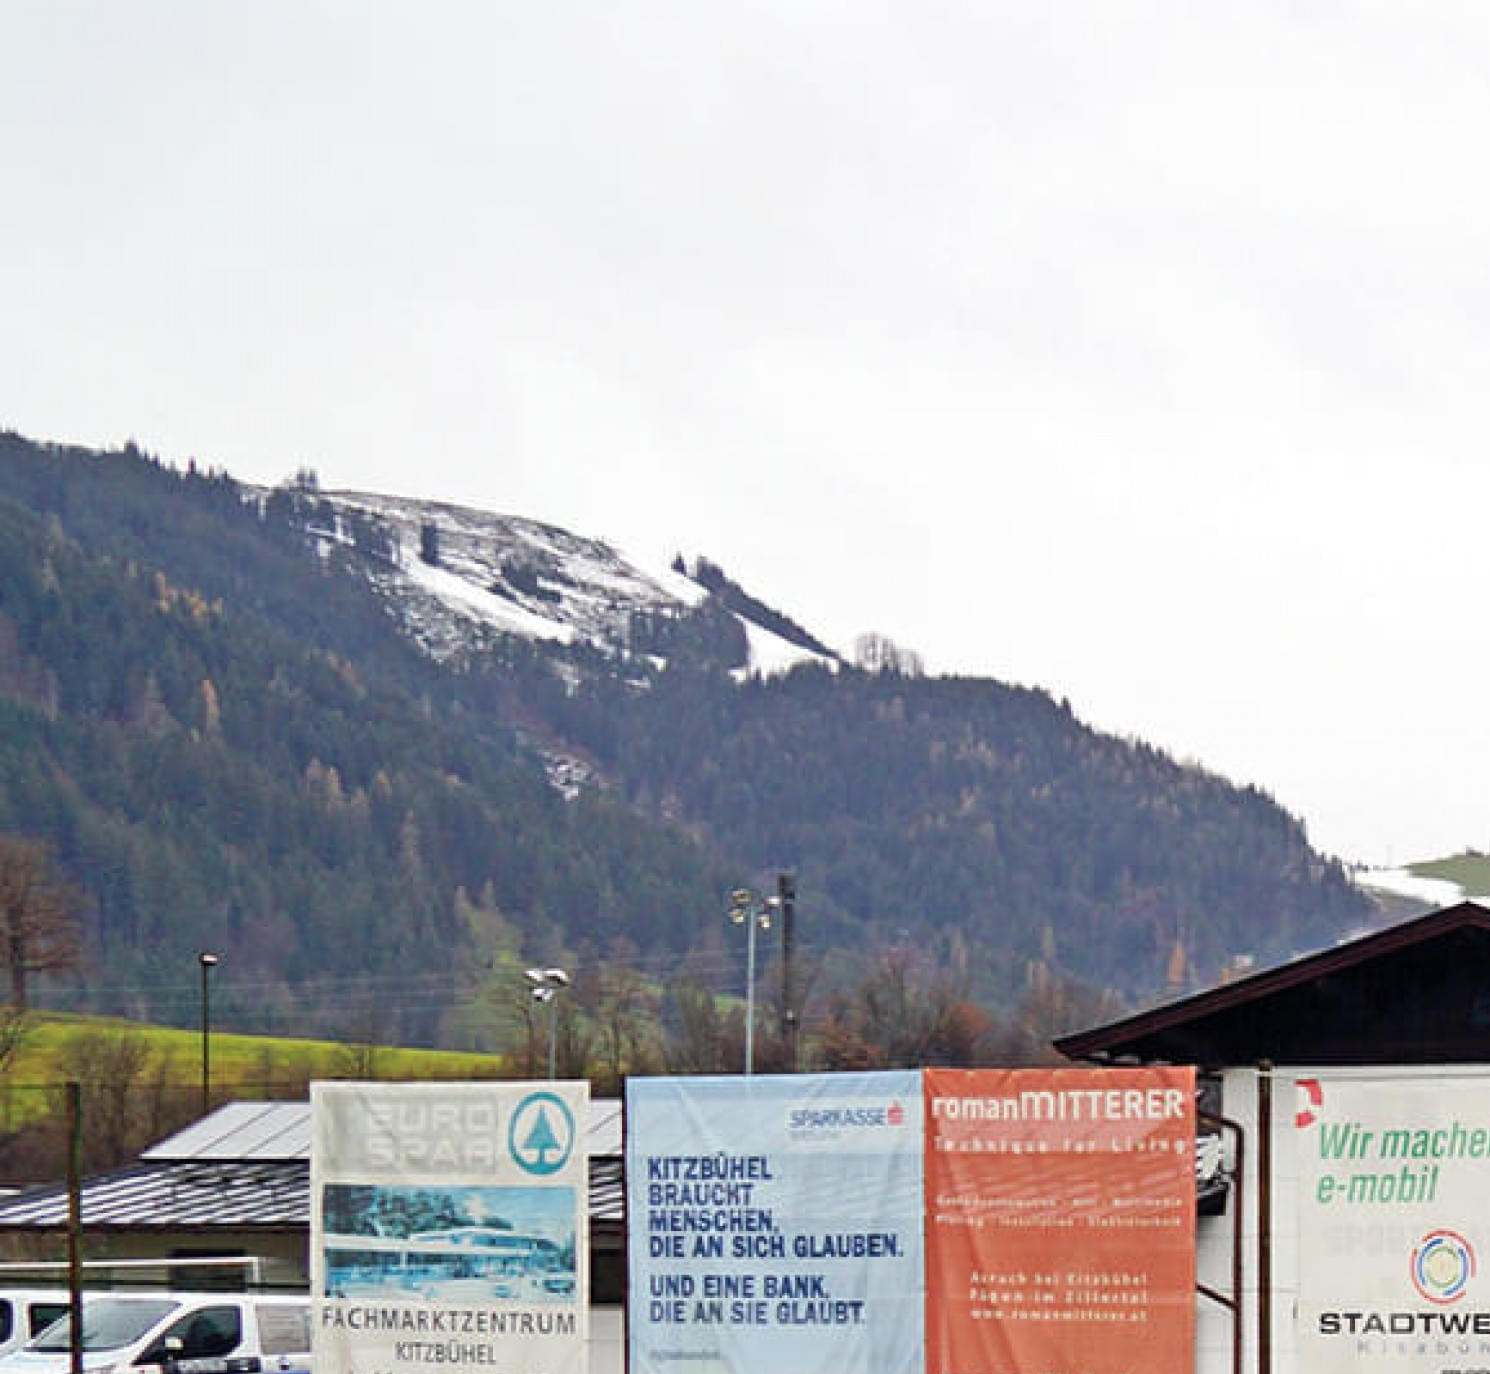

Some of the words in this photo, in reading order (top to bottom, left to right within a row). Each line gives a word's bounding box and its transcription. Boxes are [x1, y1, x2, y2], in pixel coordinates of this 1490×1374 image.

[368, 1102, 496, 1133] EURO
[790, 1107, 885, 1128] SPARKASSE
[931, 1089, 1185, 1121] romanMITTERER
[368, 1136, 495, 1167] SPAR
[1318, 1122, 1374, 1160] Wir
[648, 1152, 773, 1180] KITZBÜHEL
[648, 1184, 754, 1206] BRAUCHT
[1316, 1165, 1440, 1203] e-mobil
[650, 1235, 685, 1257] DIE
[692, 1235, 723, 1257] AN
[732, 1235, 784, 1257] SICH
[794, 1234, 904, 1257] GLAUBEN.
[650, 1274, 694, 1298] UND
[704, 1275, 755, 1298] EINE
[321, 1307, 576, 1335] FACHMARKTZENTRUM
[650, 1301, 686, 1324] DIE
[693, 1301, 724, 1324] AN
[730, 1301, 768, 1324] SIE
[394, 1339, 497, 1365] KITZBÜHEL
